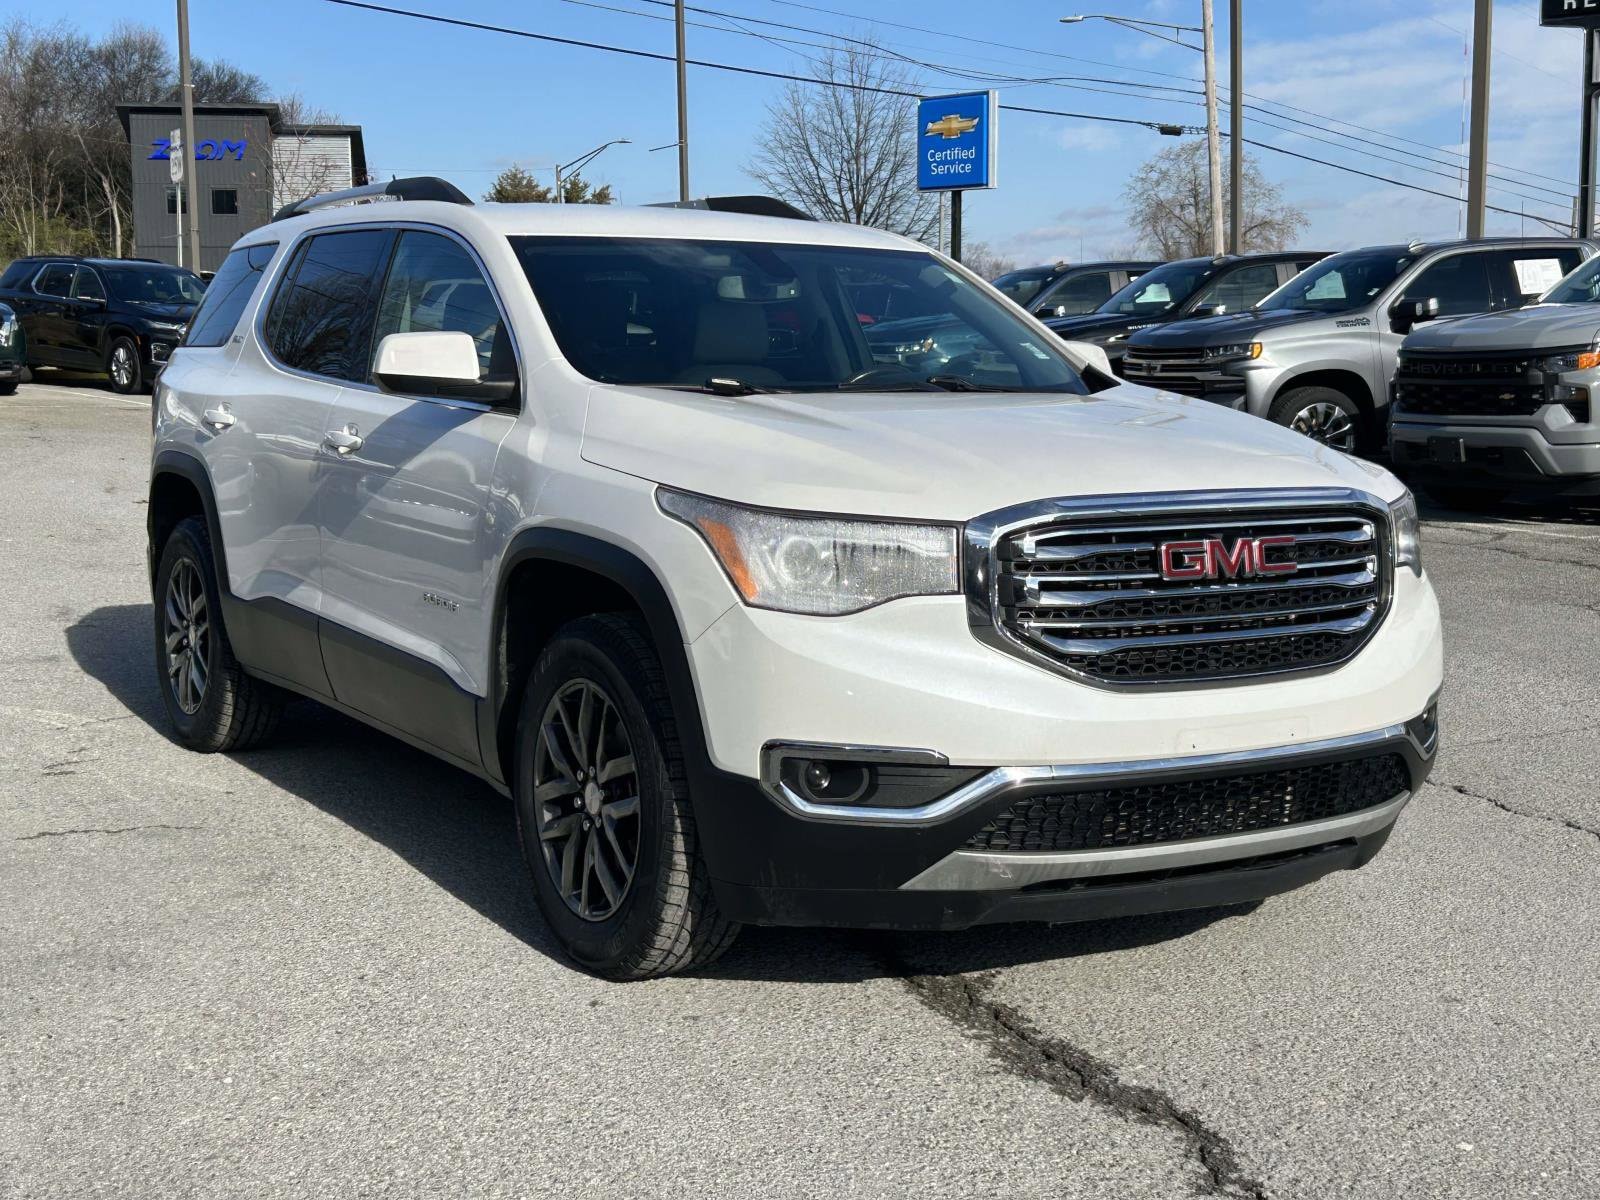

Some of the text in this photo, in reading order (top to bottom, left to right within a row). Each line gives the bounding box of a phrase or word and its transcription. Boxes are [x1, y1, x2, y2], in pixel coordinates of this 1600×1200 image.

[147, 138, 249, 161] ZOM
[927, 146, 976, 162] Certified
[930, 161, 972, 175] Service
[1160, 534, 1299, 581] GMC
